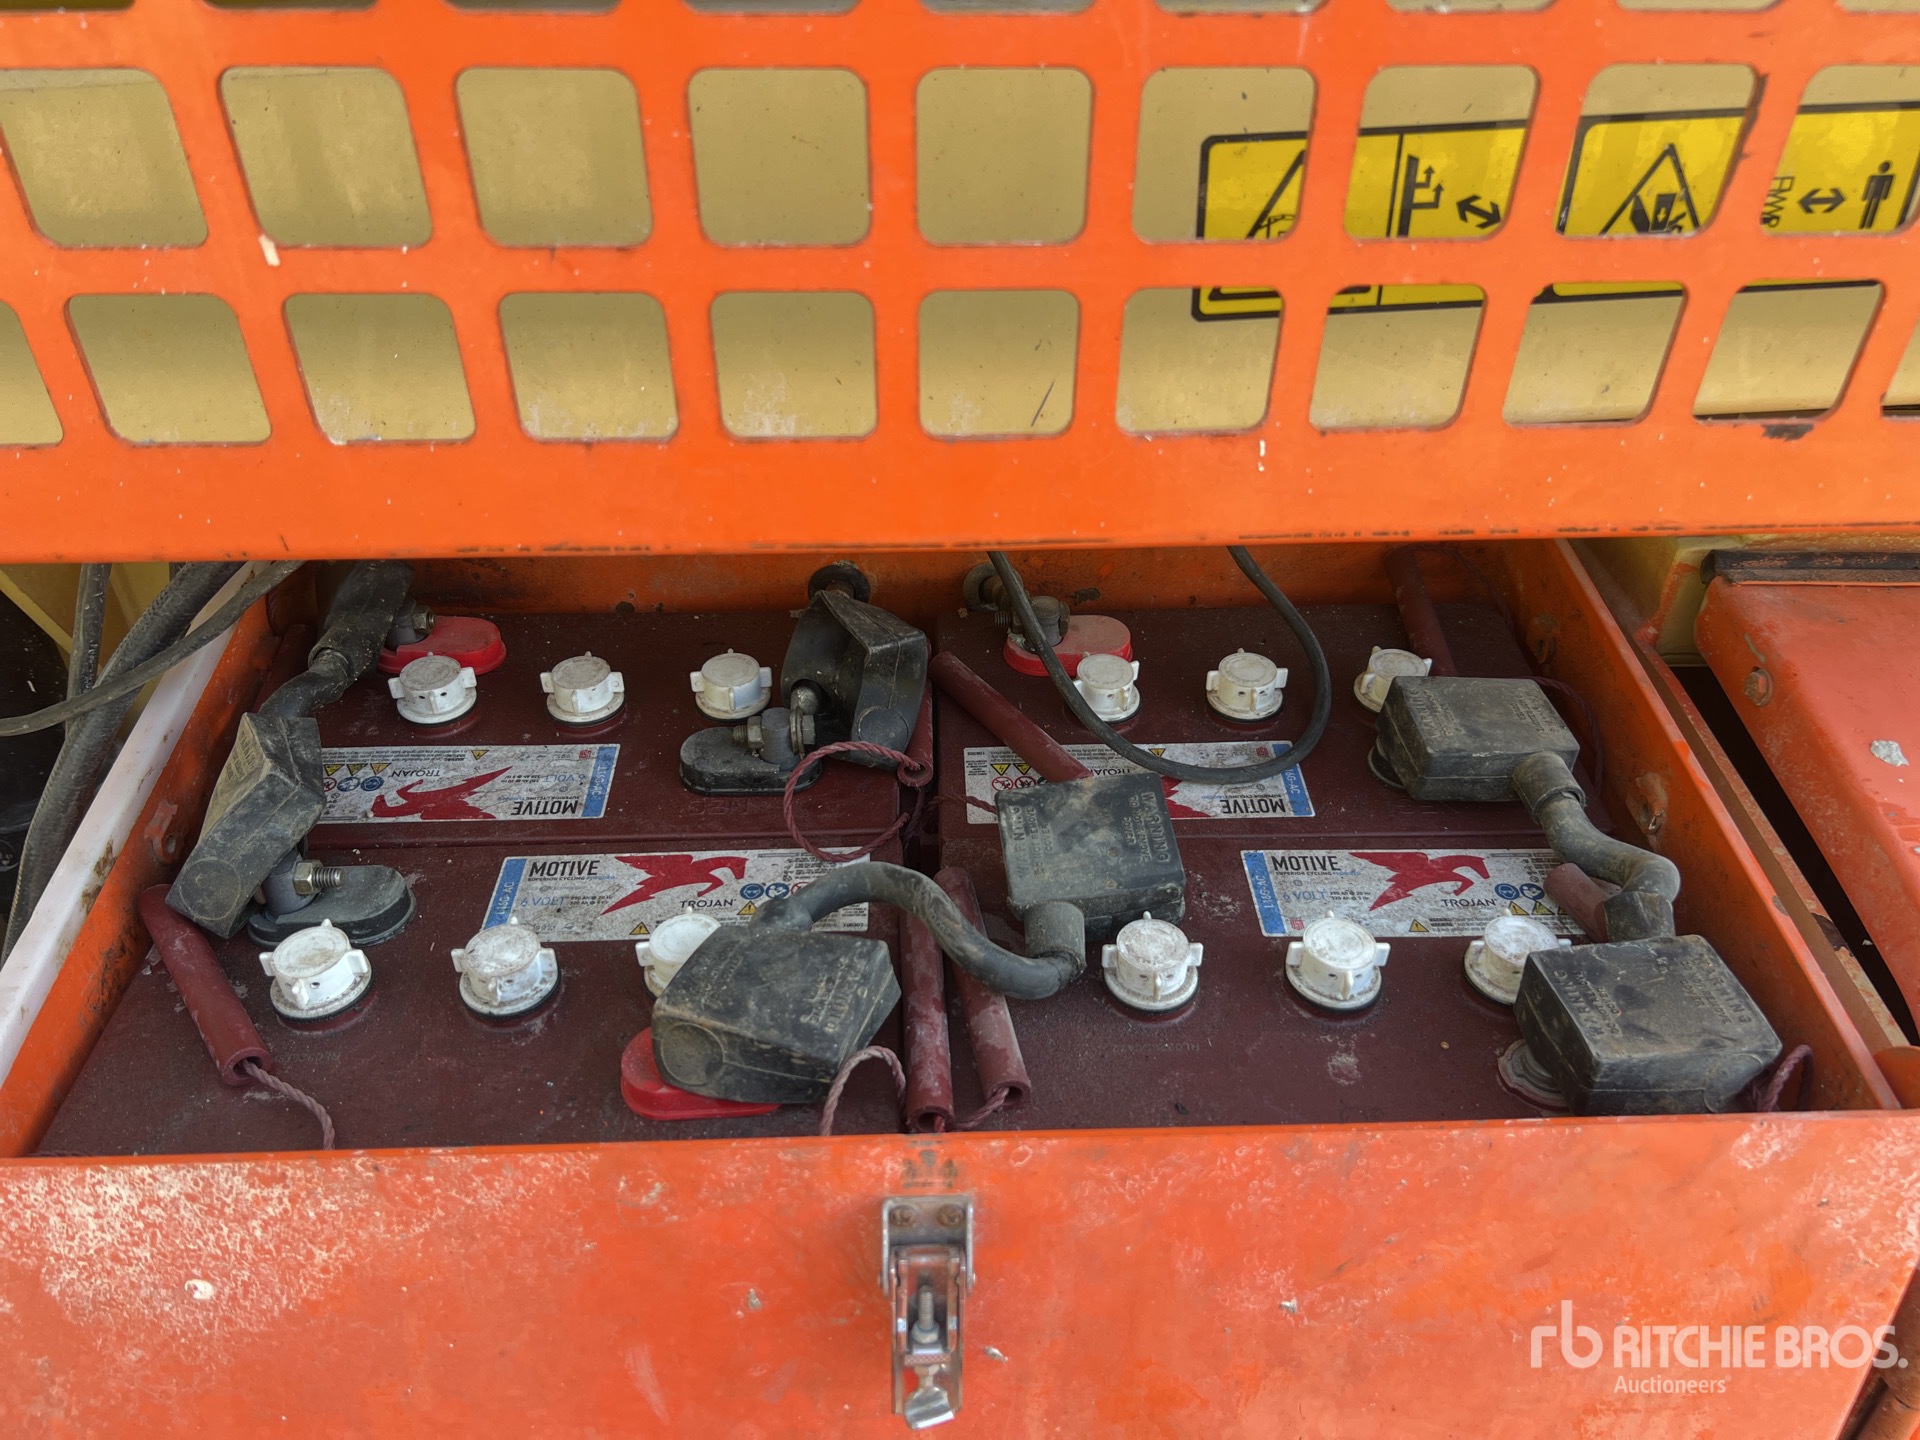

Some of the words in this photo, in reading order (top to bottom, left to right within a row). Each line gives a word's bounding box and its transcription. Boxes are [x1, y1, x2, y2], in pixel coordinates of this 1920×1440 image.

[391, 769, 441, 778] TROJAN
[543, 774, 575, 782] VOLT
[1090, 768, 1131, 777] TROJA
[1285, 769, 1301, 794] 16G-AC
[510, 800, 579, 816] MOTIVE
[1220, 798, 1285, 815] MOTIVE
[1121, 816, 1136, 845] COVER
[1140, 791, 1170, 863] WARNING
[1008, 804, 1030, 878] WARNING
[1135, 826, 1152, 862] REMOVE
[528, 860, 601, 877] MOTIVE
[1272, 856, 1341, 871] MOTIVE
[520, 897, 528, 907] 6
[532, 896, 566, 906] VOLT
[1283, 892, 1289, 900] 6
[1292, 890, 1327, 900] VOLT
[1441, 898, 1496, 907] TROJAN
[680, 899, 733, 909] TROJAN
[1550, 969, 1607, 1036] WARNING
